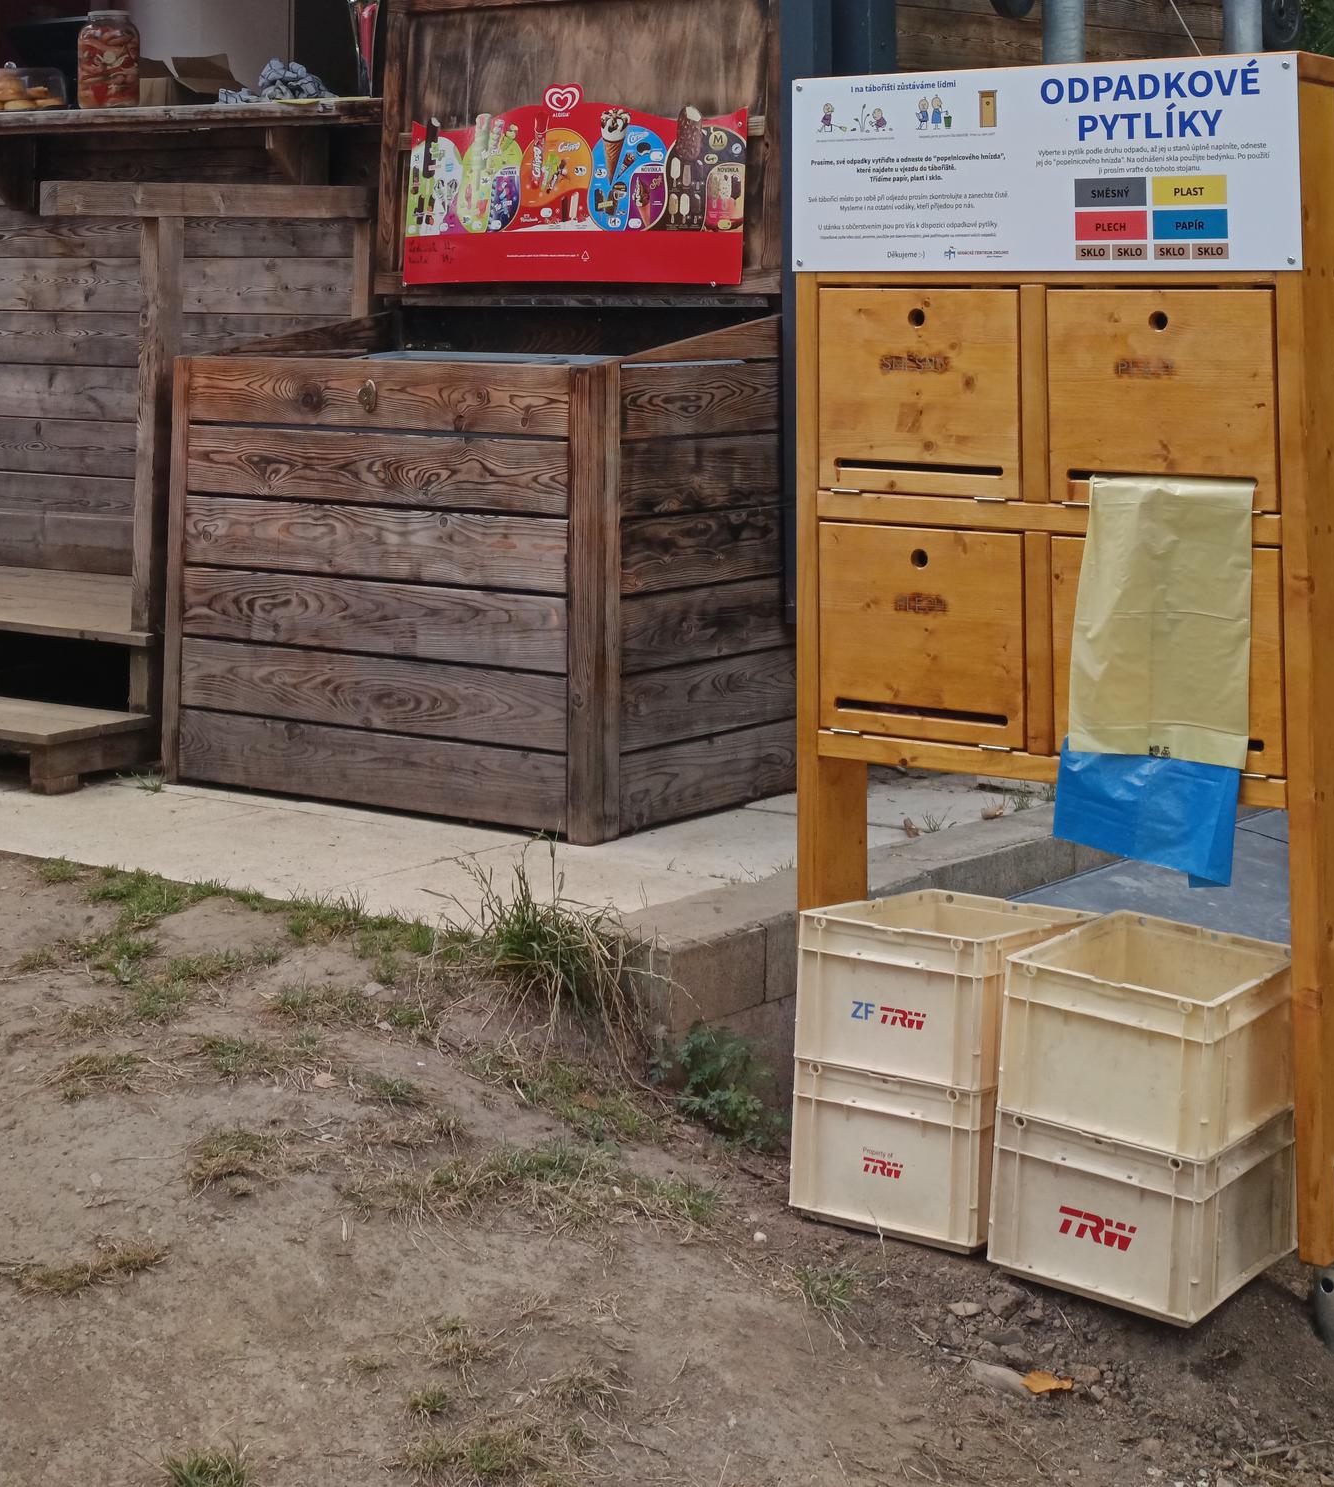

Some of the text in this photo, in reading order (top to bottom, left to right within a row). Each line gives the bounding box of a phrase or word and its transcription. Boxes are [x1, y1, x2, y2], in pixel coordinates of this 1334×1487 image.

[865, 82, 895, 92] tábořišti
[897, 80, 935, 91] zůstáváme
[1040, 59, 1260, 105] ODPADKOVÉ
[1078, 102, 1223, 141] PYTLÍKY
[1086, 147, 1103, 155] podle
[1104, 146, 1122, 154] druhu
[846, 156, 871, 165] odpadky
[872, 166, 894, 174] najdete
[900, 165, 918, 173] vjezdu
[839, 194, 854, 202] místo
[886, 193, 907, 202] odjezdu
[1091, 186, 1204, 198] SMĚSNÝ PLAST
[1096, 219, 1204, 231] PLECH PAPÍR
[887, 250, 917, 260] Děkujeme
[1081, 246, 1224, 257] SKLO SKLO SKLO SKLO
[851, 1000, 928, 1031] ZF TRW
[862, 1146, 894, 1160] Property of
[862, 1157, 904, 1179] TRW
[1058, 1206, 1138, 1253] TRW
